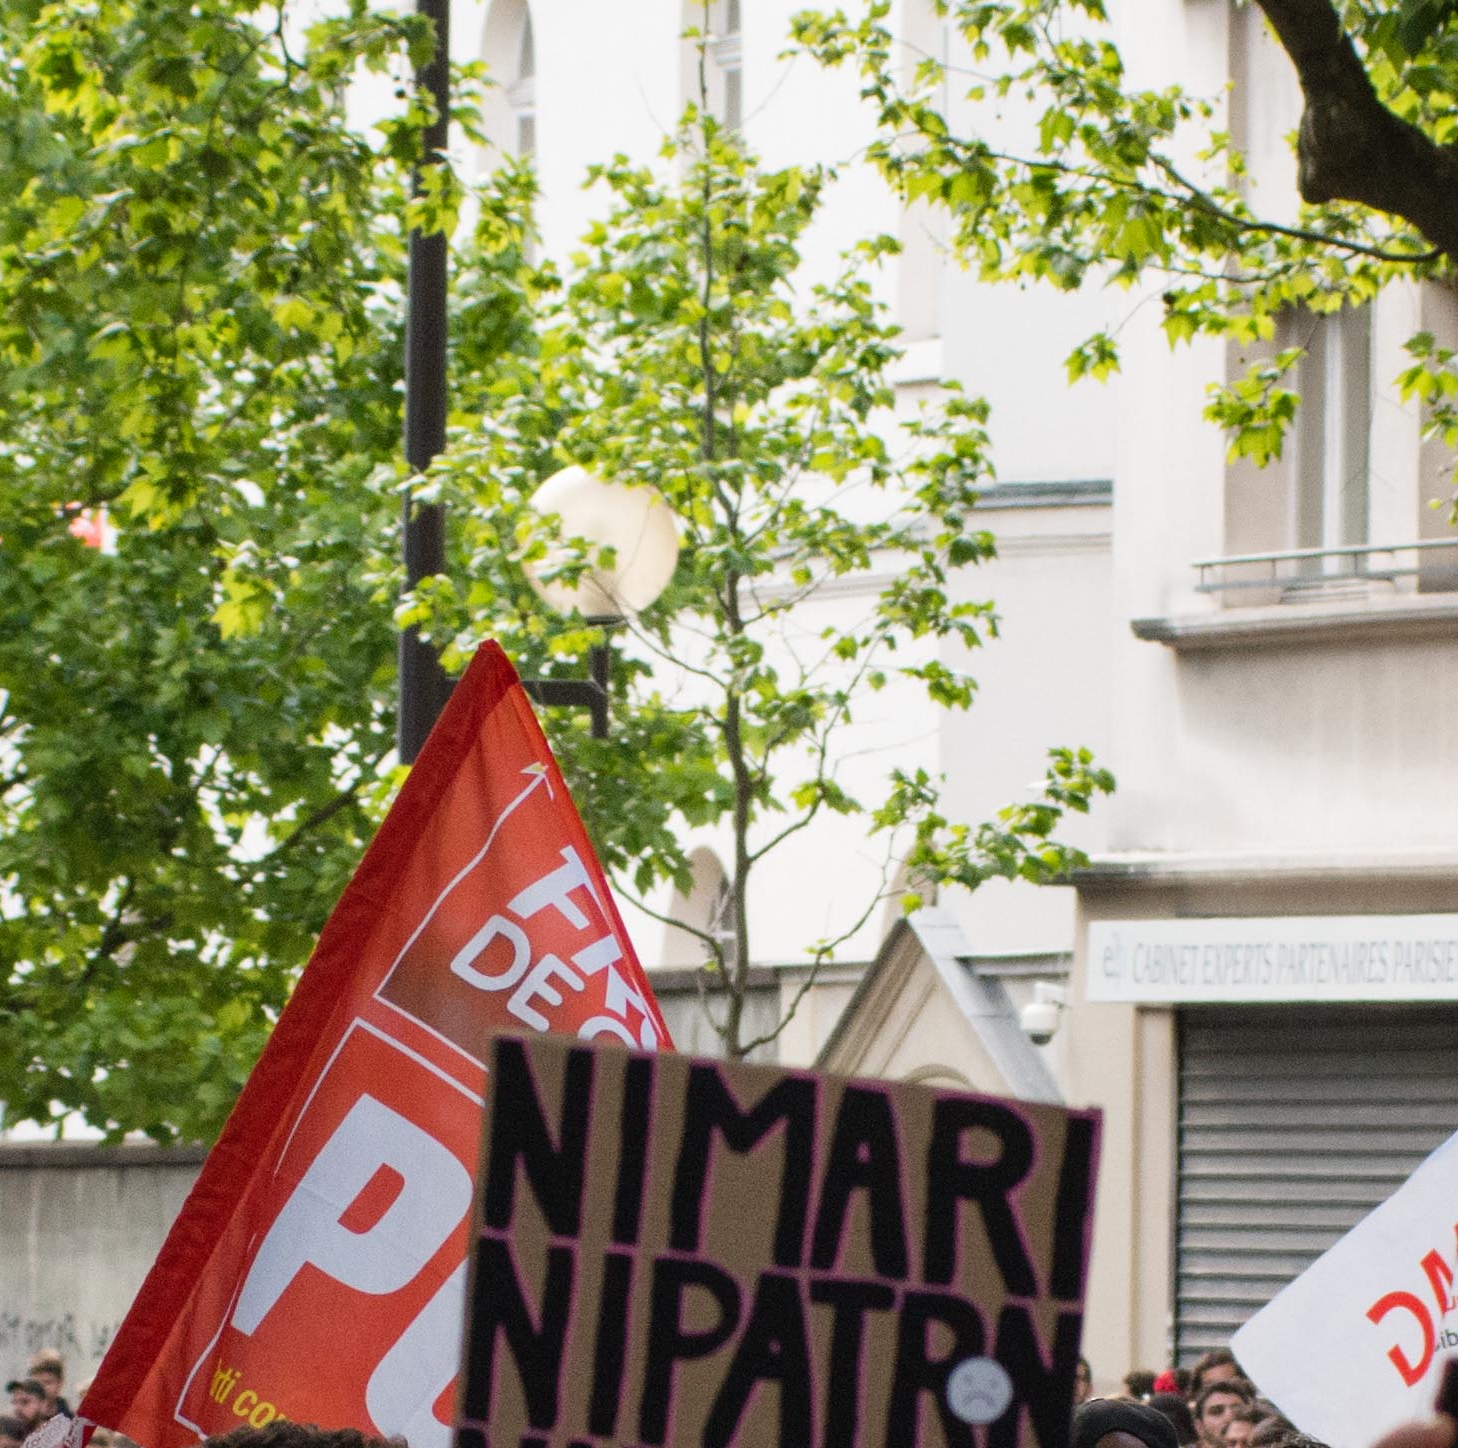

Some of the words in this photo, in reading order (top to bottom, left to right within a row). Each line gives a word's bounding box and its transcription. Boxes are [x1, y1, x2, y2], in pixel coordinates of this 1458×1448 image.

[450, 914, 584, 1033] DE
[1131, 943, 1200, 984] CABINET
[1203, 942, 1273, 984] EXPERTS
[1278, 940, 1389, 984] PARTENAIRES
[484, 1036, 656, 1246] NI
[669, 1060, 1100, 1300] MARI
[460, 1237, 636, 1440] NI
